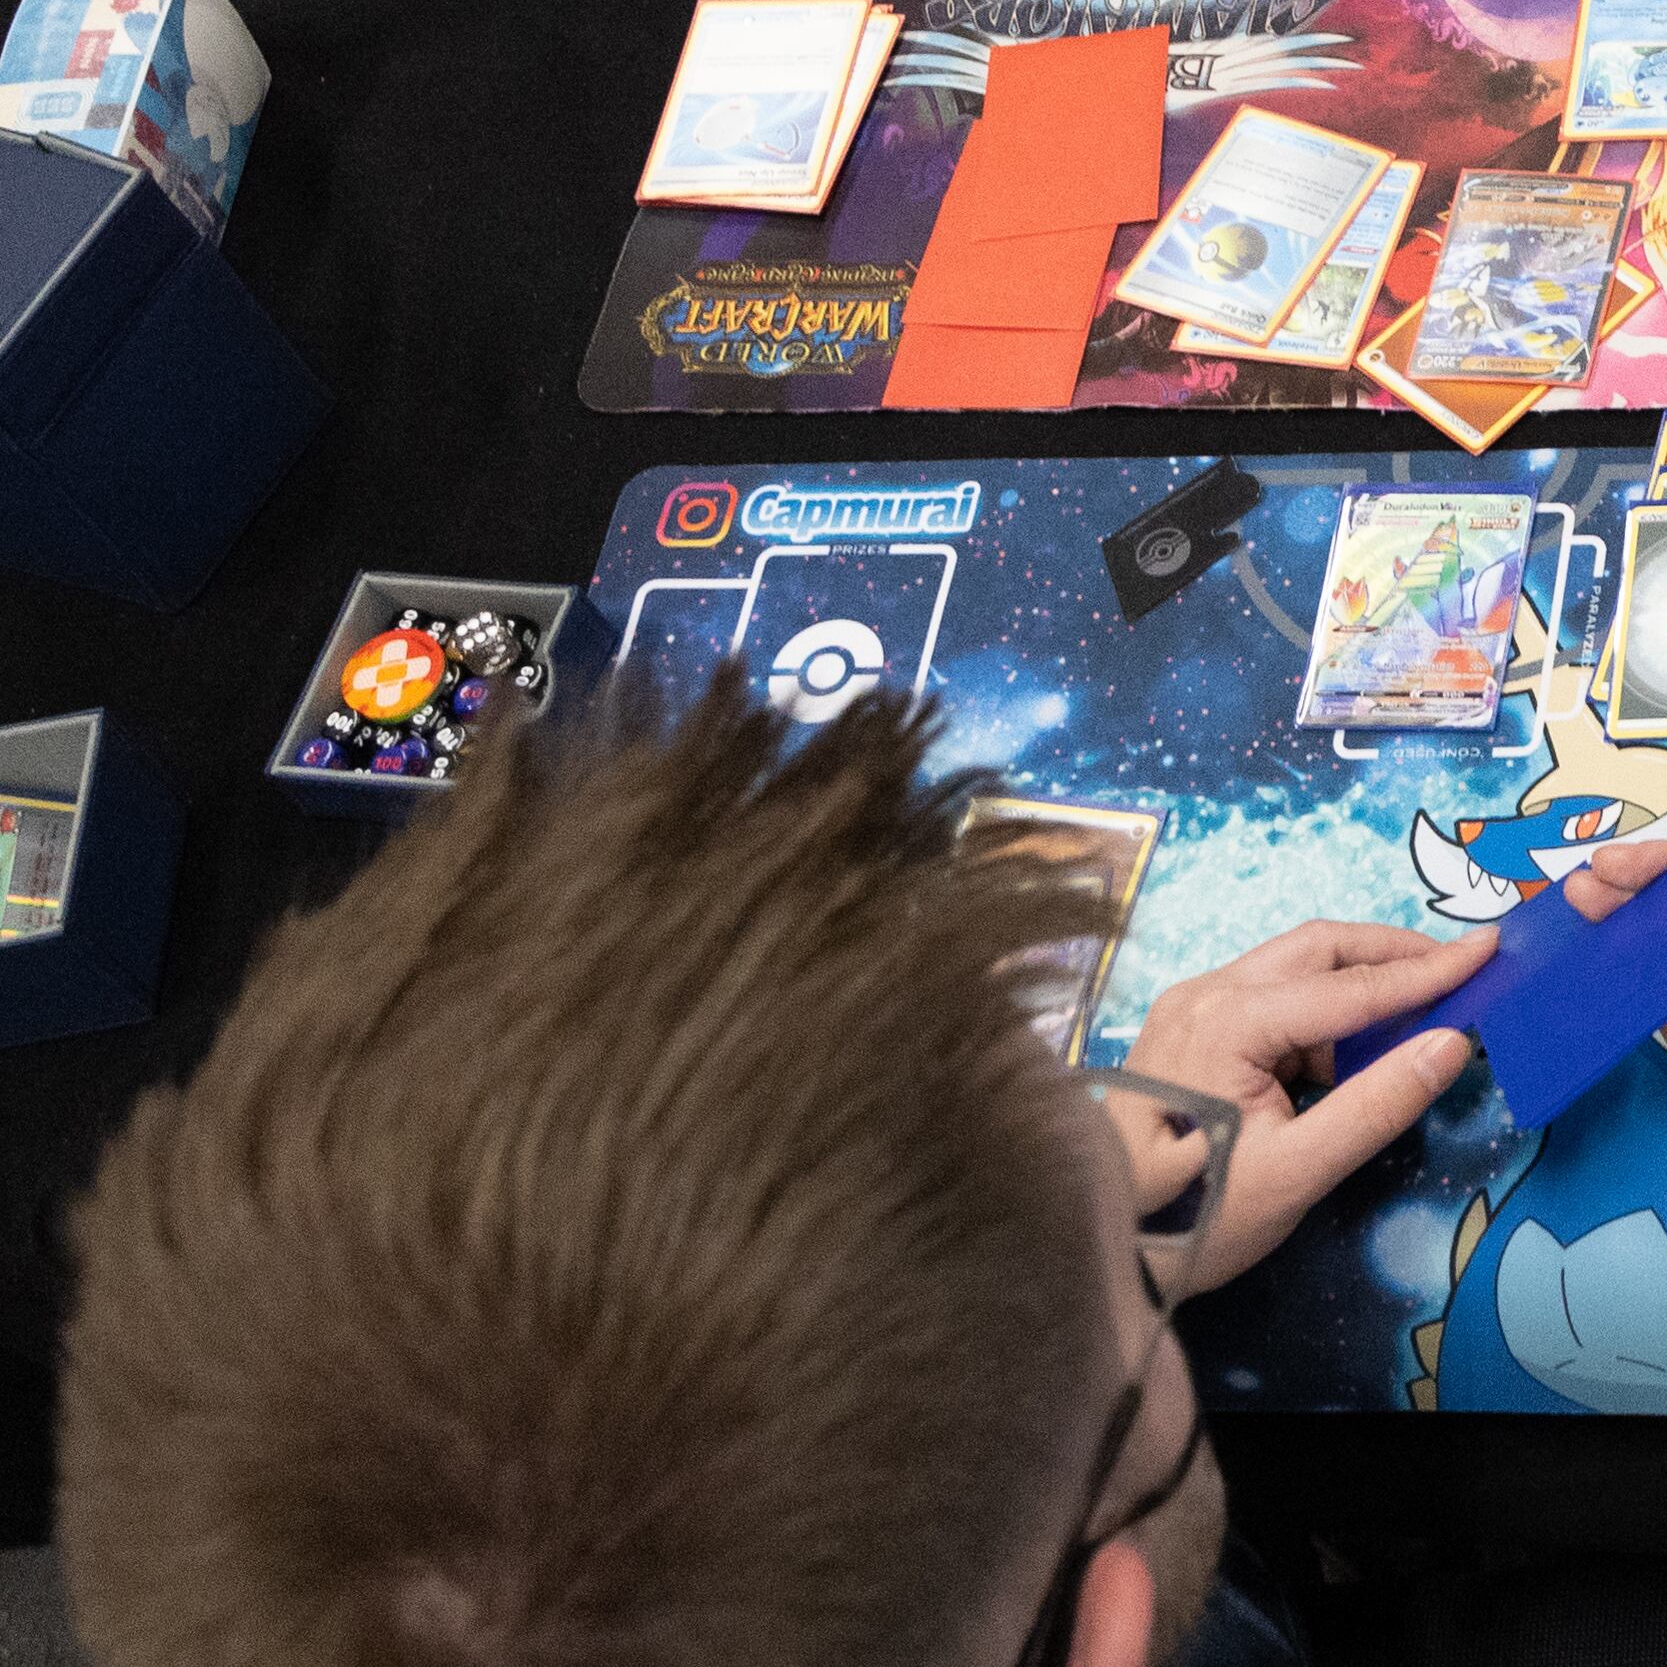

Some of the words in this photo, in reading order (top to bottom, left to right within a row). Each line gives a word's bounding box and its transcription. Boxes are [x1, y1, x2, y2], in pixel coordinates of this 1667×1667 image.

[674, 293, 892, 342] WARCRAFT
[698, 340, 846, 365] WORLD
[741, 481, 982, 542] Capmurai
[832, 544, 888, 556] PRIZES
[1582, 584, 1602, 666] PARALYZE
